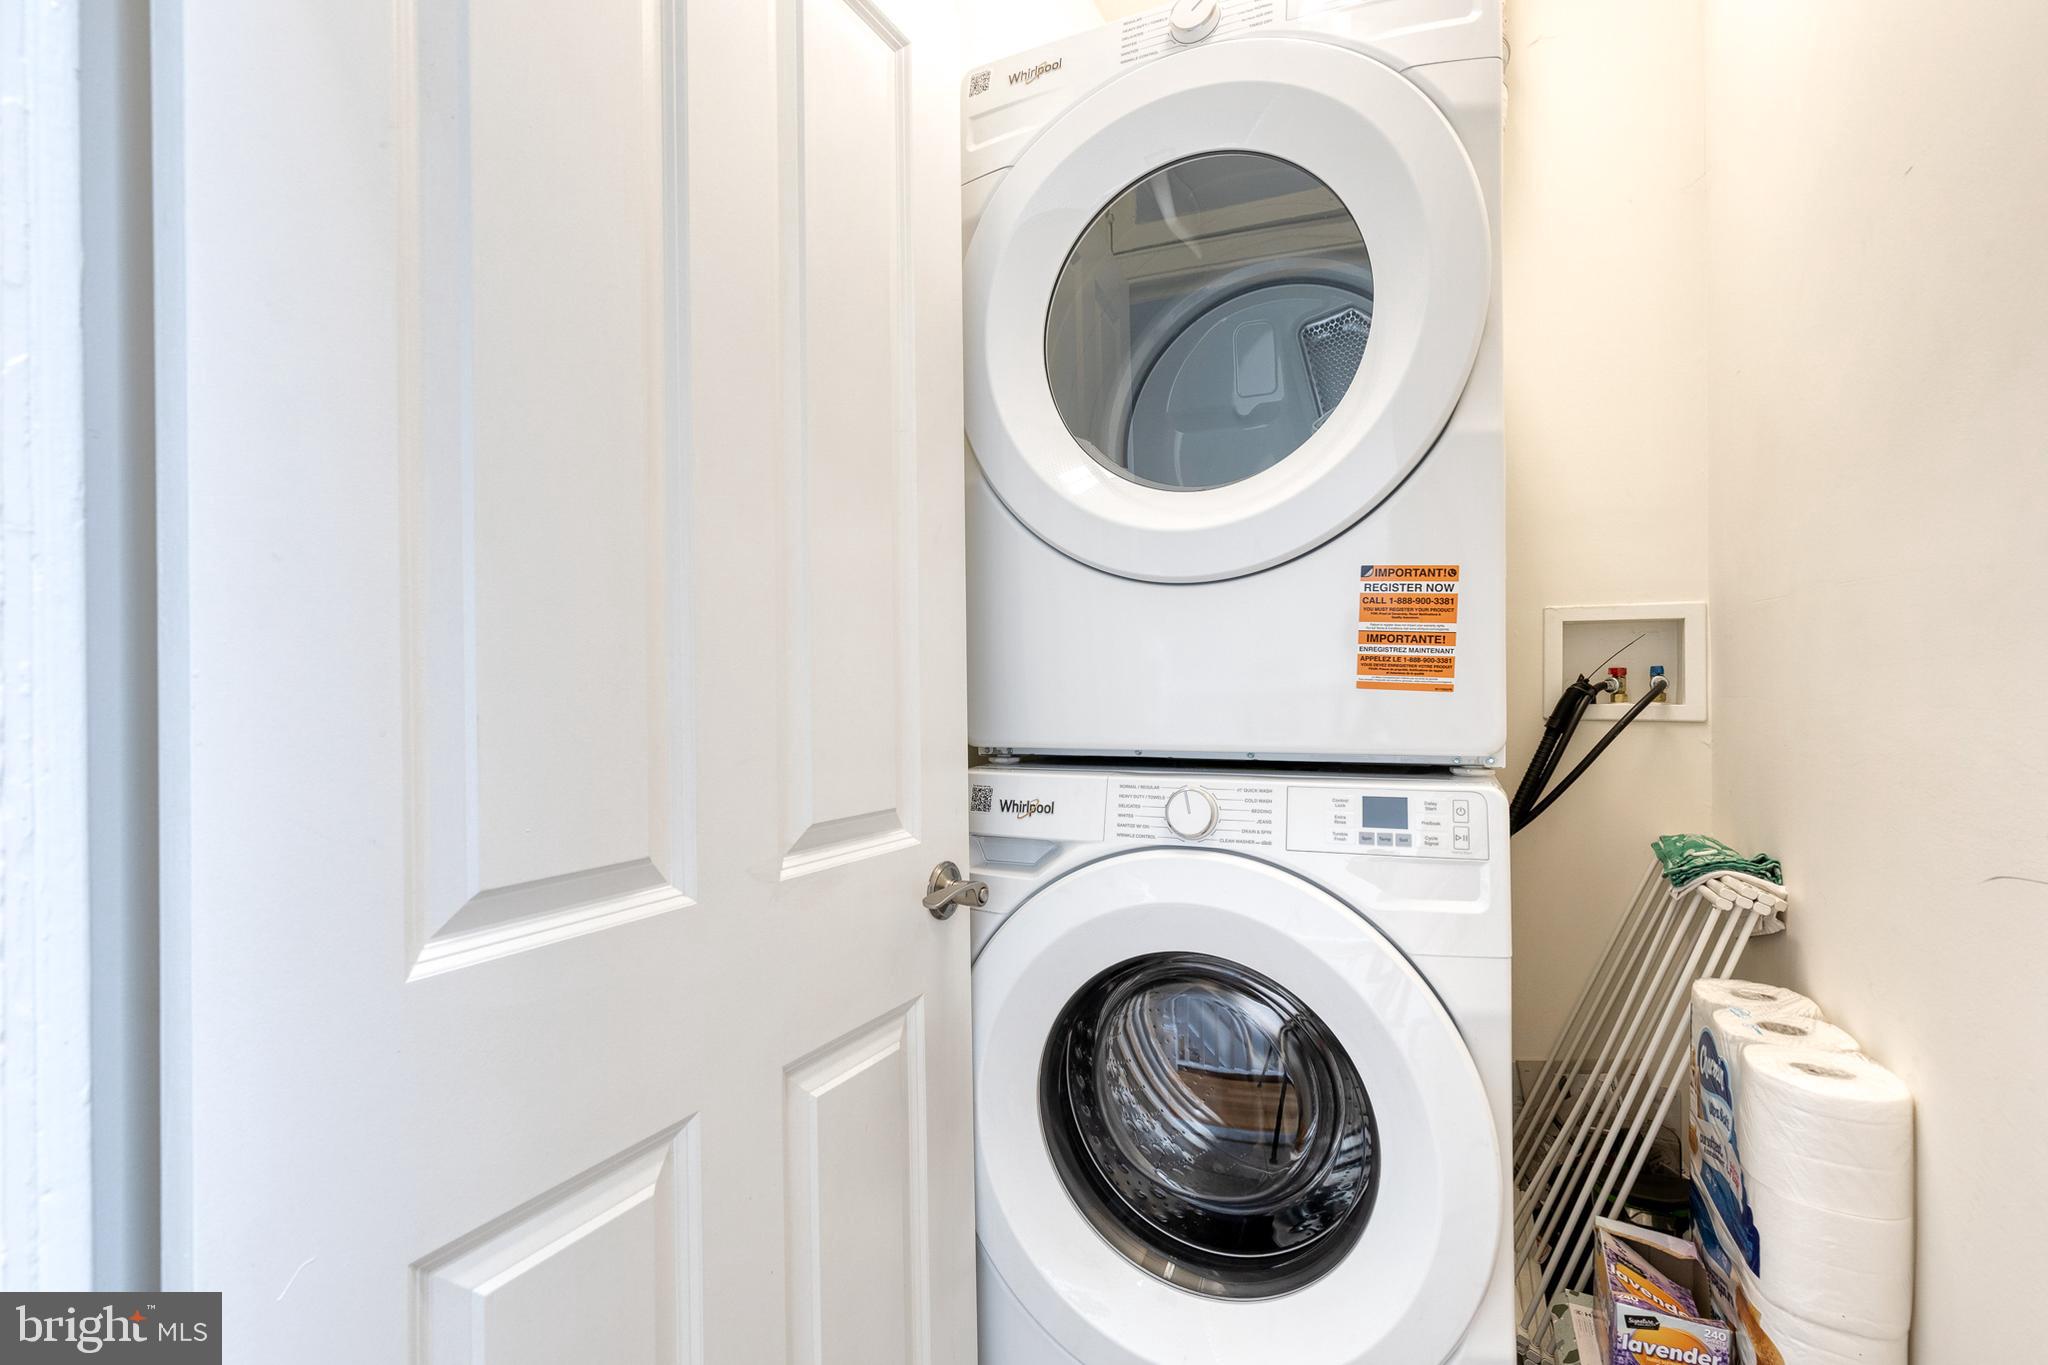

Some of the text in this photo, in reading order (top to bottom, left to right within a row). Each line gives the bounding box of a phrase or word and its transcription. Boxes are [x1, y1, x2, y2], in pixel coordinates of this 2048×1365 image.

[1008, 57, 1063, 86] Whirlpool
[1374, 568, 1447, 578] IMPORTANT!
[1364, 583, 1455, 593] REGISTER NOW
[1362, 596, 1455, 605] CALL 1-888-900-3381
[1366, 633, 1446, 644] IMPORTANTE!
[1360, 655, 1391, 663] APPELEZ
[999, 798, 1055, 818] Whirlpool
[1610, 1264, 1690, 1319] lavende
[1704, 1328, 1727, 1342] 240
[1621, 1333, 1722, 1365] lavender
